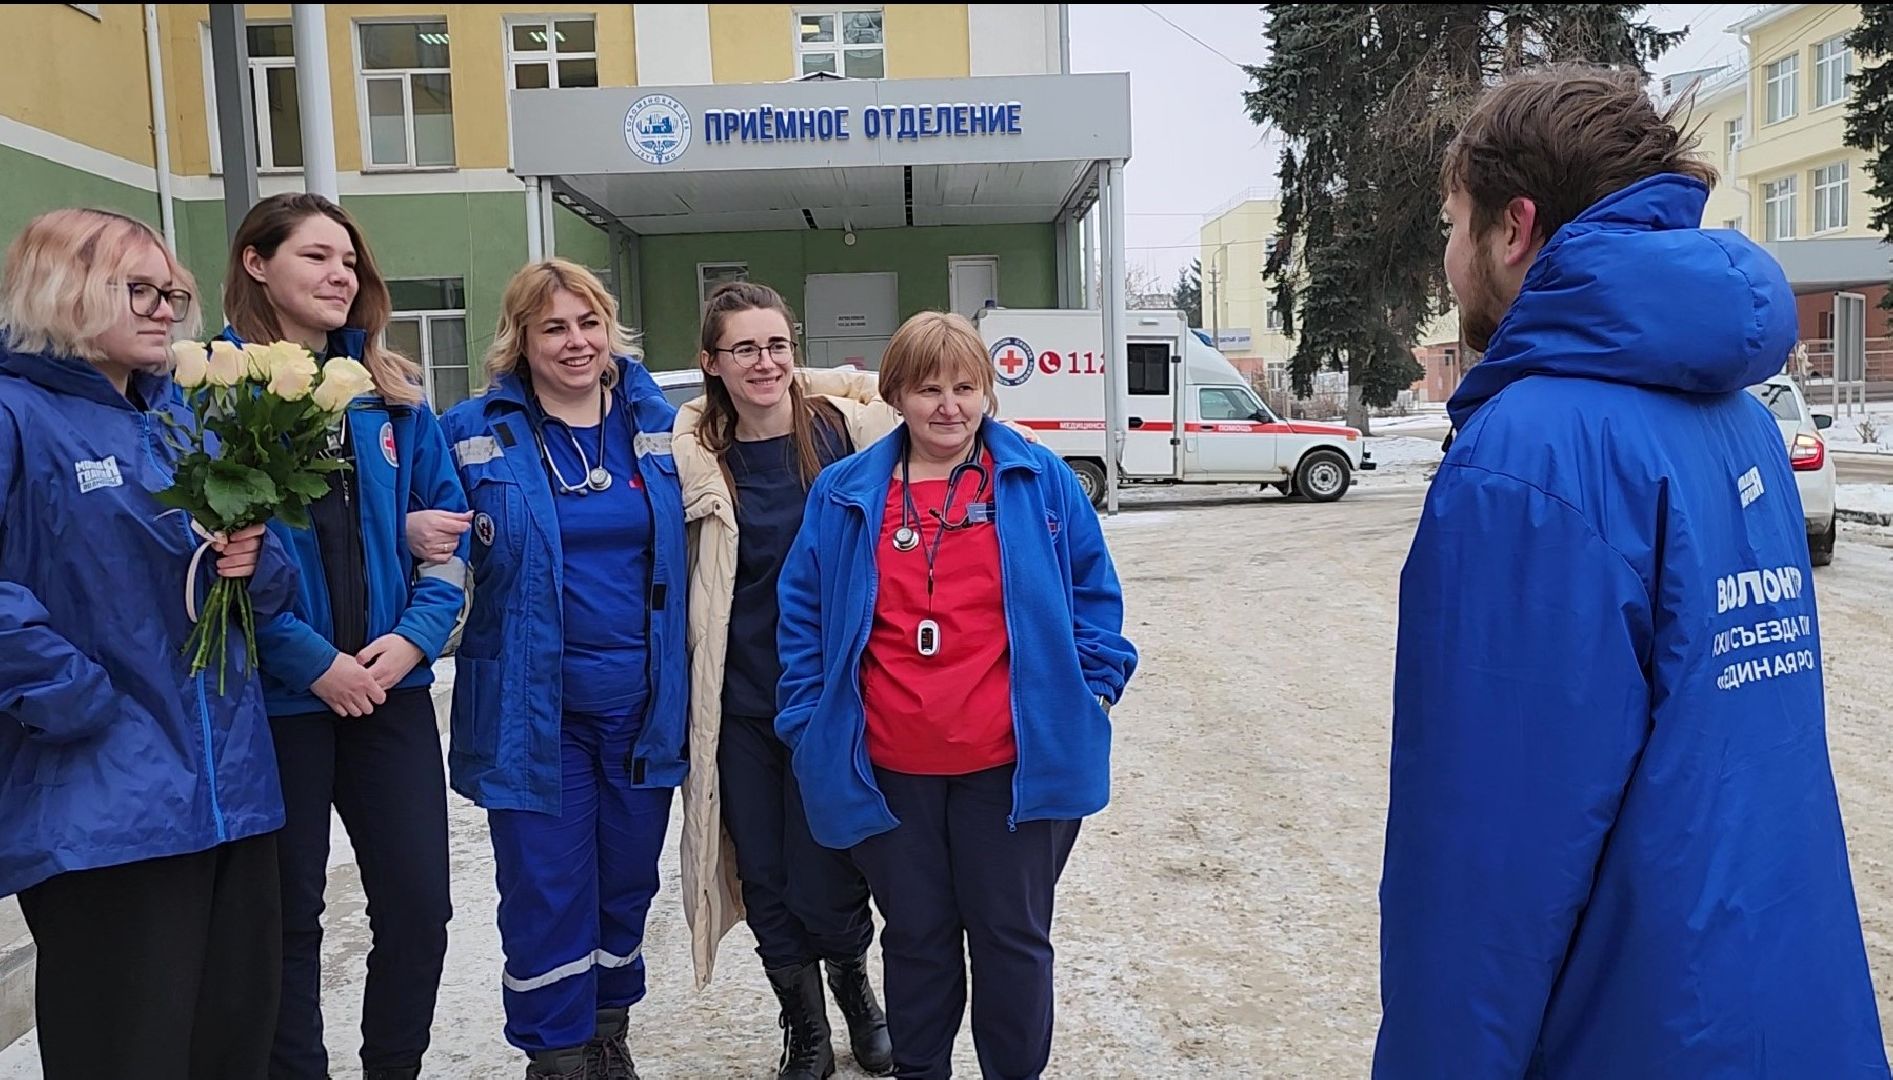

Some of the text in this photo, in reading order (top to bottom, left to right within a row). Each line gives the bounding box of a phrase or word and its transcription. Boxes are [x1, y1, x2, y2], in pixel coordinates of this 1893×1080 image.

[705, 103, 1022, 143] ПРИЁМНОЕ ОТДЕЛЕНИЕ
[1218, 424, 1252, 432] ПОМОЩЬ
[1731, 616, 1801, 649] СЪЕЗДА
